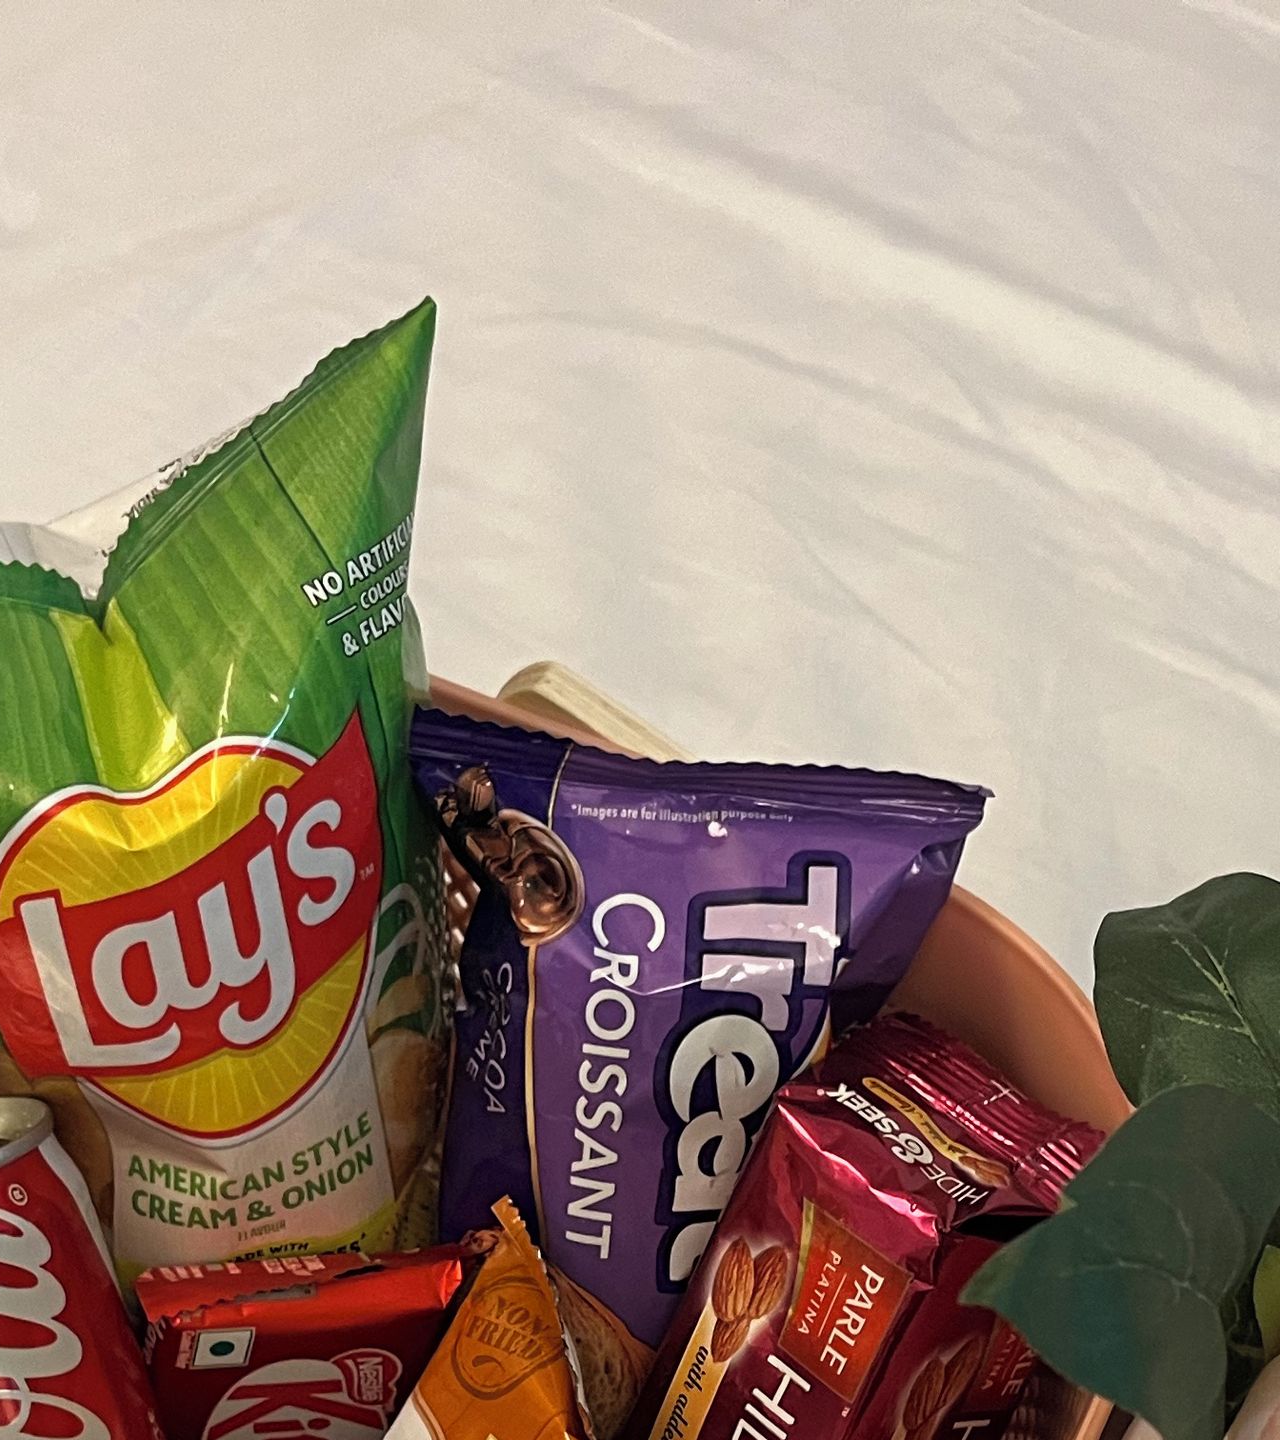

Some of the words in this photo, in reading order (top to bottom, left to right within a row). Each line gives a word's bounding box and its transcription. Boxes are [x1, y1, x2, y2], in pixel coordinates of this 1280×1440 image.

[302, 571, 343, 606] NO
[342, 632, 360, 656] &
[359, 593, 407, 645] FLAV
[641, 806, 657, 822] for
[19, 794, 356, 1067] Lay's
[565, 892, 665, 1259] CROISSANT
[825, 1082, 900, 1134] SEEK
[128, 1154, 285, 1201] AMERICAN
[291, 1111, 372, 1175] STYLE
[882, 1131, 934, 1165] &
[132, 1189, 237, 1229] CREAM
[246, 1200, 276, 1222] &
[281, 1143, 374, 1209] ONION
[920, 1163, 989, 1205] HIDE
[269, 1242, 310, 1255] WITH
[488, 1296, 550, 1337] NON
[797, 1250, 842, 1335] PLATINA
[467, 1315, 542, 1360] FRIED
[820, 1264, 885, 1376] PARLE
[684, 1345, 709, 1393] with
